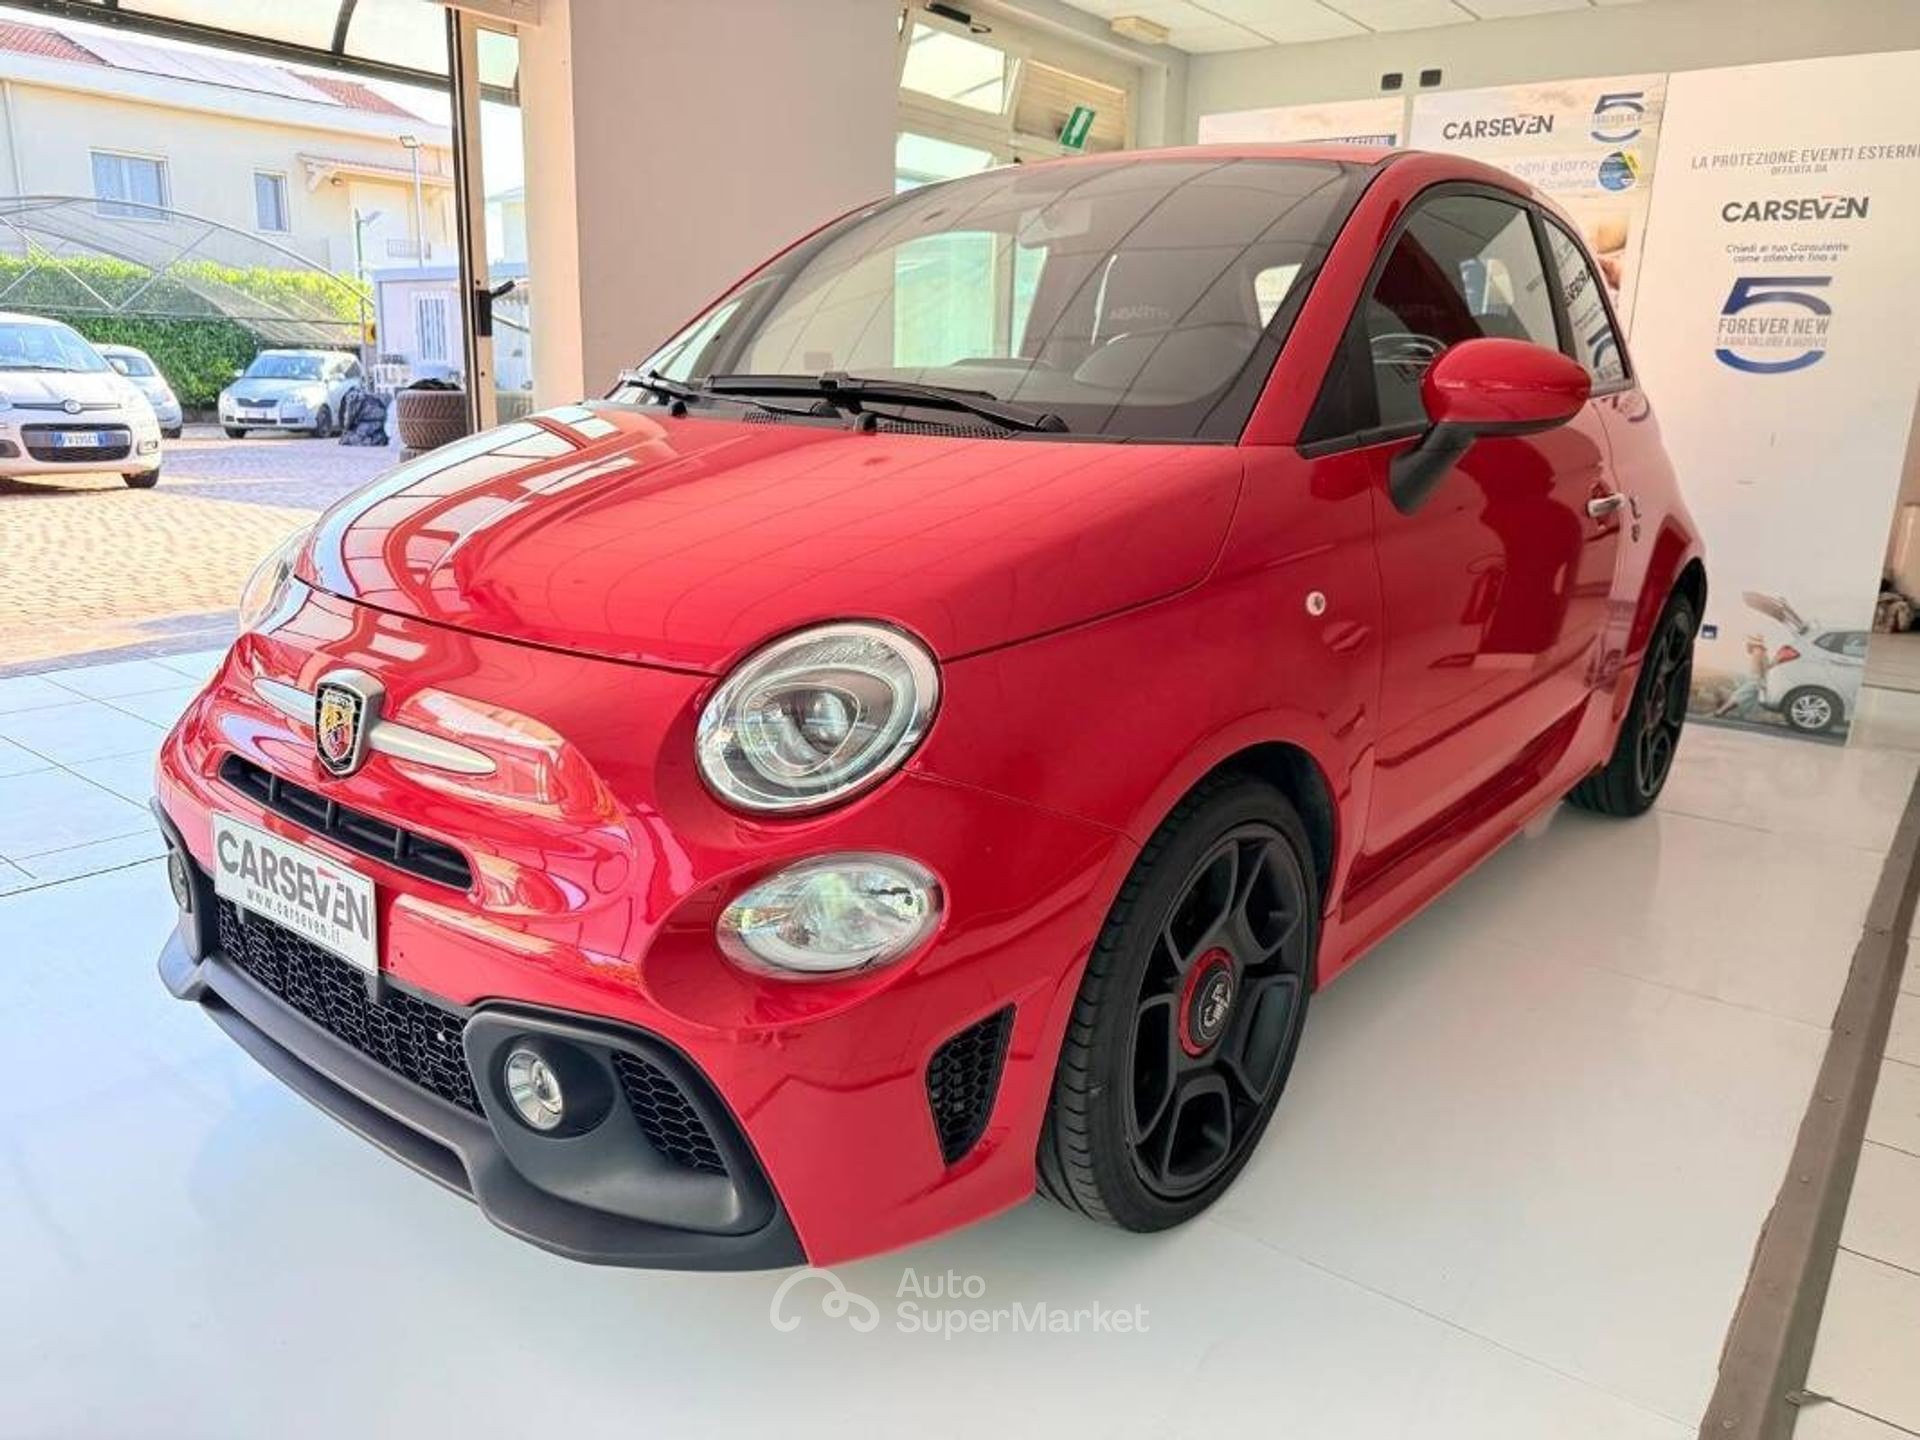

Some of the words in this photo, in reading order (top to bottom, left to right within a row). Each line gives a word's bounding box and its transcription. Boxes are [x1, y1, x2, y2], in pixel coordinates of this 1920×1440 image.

[1442, 114, 1554, 140] CARSEVEN
[1691, 155, 1708, 170] LA
[1711, 150, 1796, 168] PROTEZIONE
[1801, 147, 1855, 162] EVENTI
[1771, 165, 1811, 175] OFFERTA
[1721, 195, 1869, 222] CARSEVEN
[1715, 276, 1832, 374] 5
[1718, 317, 1789, 335] FOREVER
[1793, 317, 1830, 335] NEW
[217, 830, 369, 941] CARSEVEN
[247, 888, 340, 945] www.carseven.it
